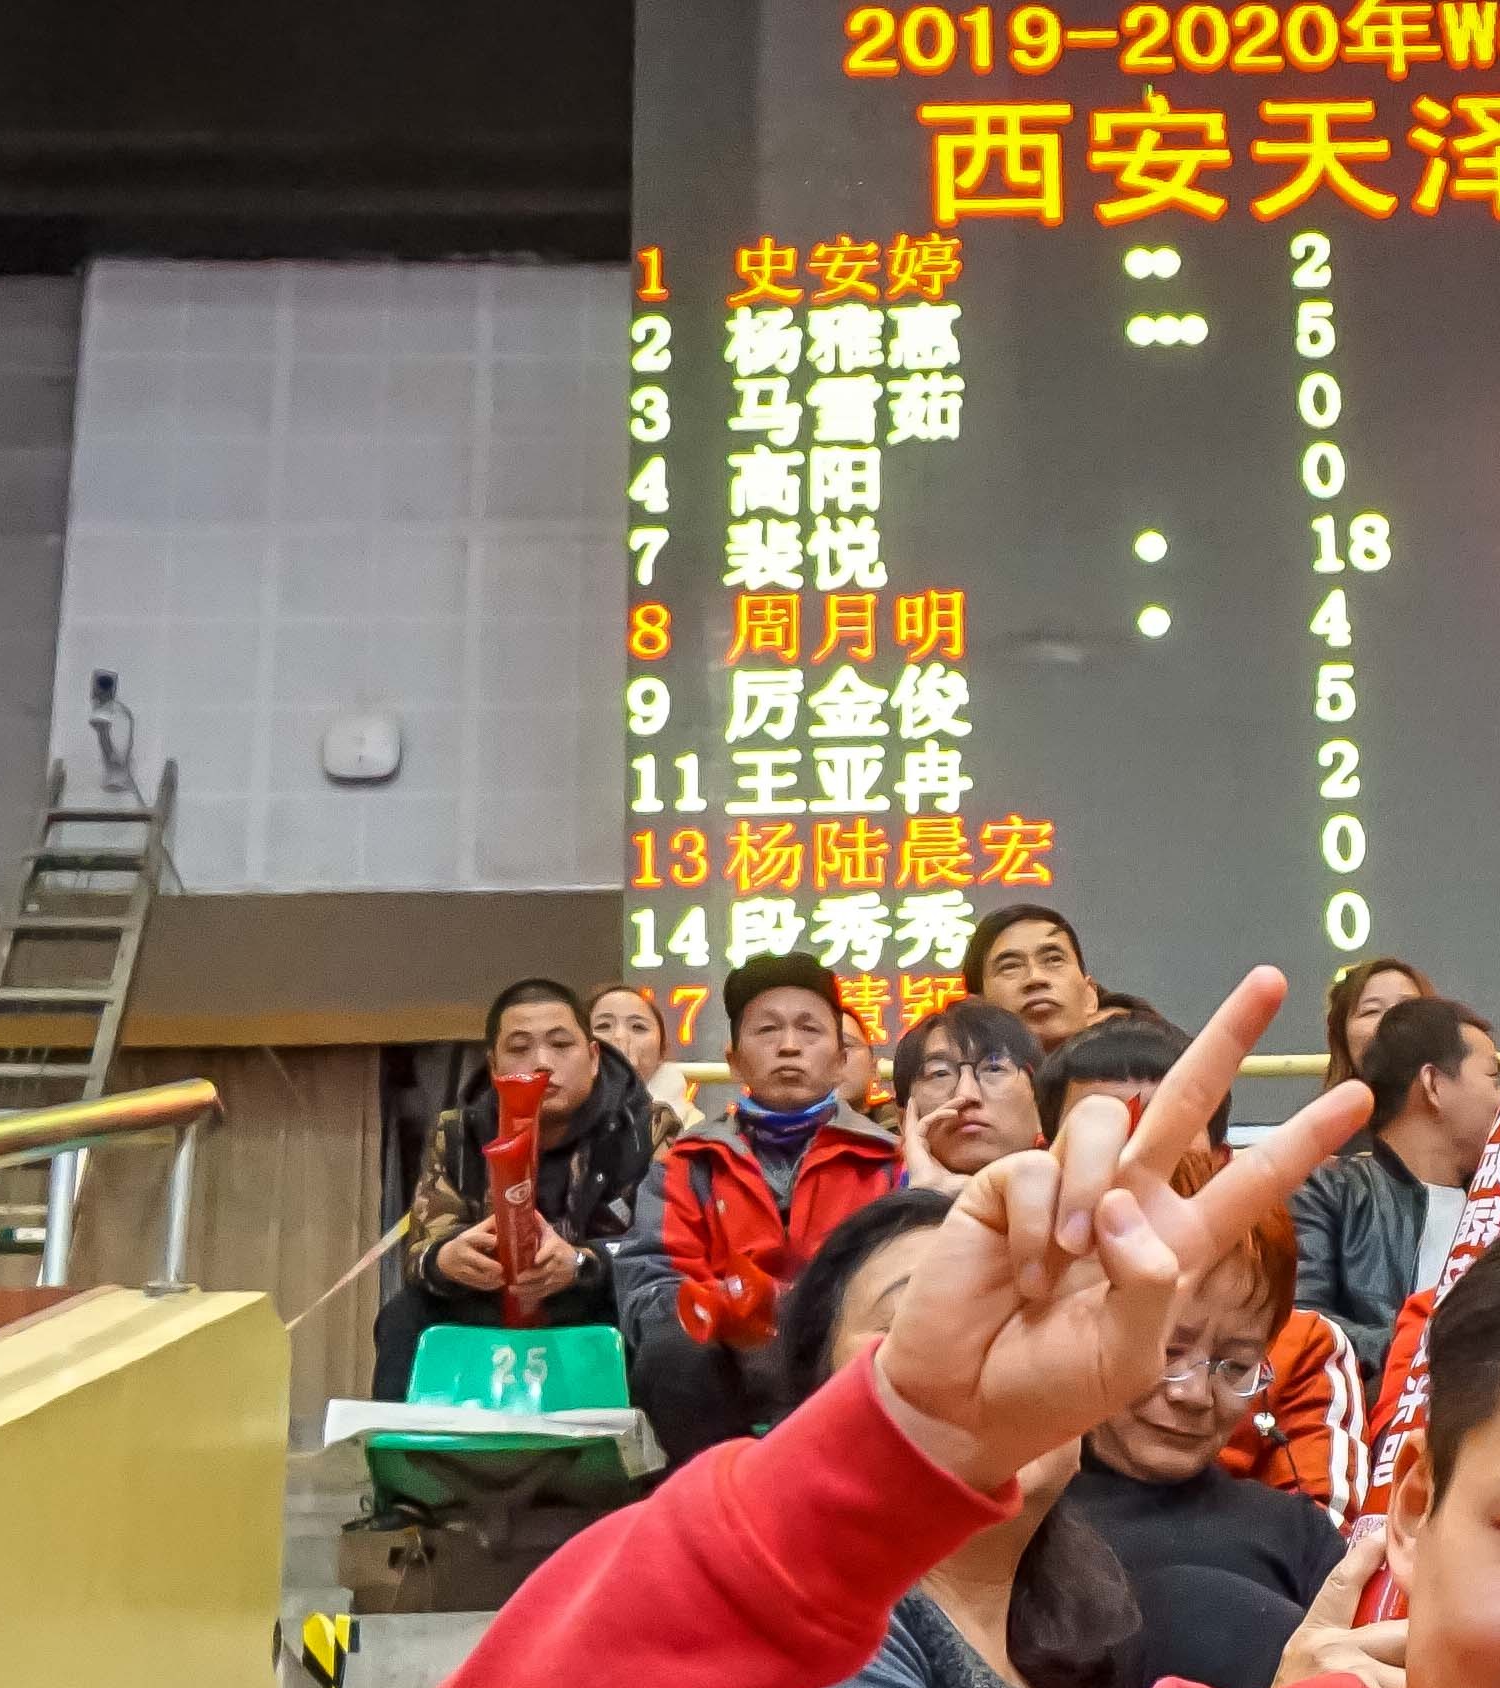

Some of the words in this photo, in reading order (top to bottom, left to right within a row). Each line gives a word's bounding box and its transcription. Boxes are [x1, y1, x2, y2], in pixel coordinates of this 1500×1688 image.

[639, 247, 668, 301] 1
[727, 233, 962, 305] 史安婷
[1291, 233, 1331, 287] 2
[632, 316, 671, 371] 2
[1297, 302, 1335, 357] 5
[631, 386, 670, 442] 3
[1299, 373, 1341, 428] 0
[629, 457, 669, 512] 4
[728, 444, 881, 520] 高阳
[1303, 442, 1345, 498] 0
[630, 528, 669, 585] 7
[1312, 514, 1391, 573] 18
[627, 602, 671, 660] 8
[725, 589, 965, 667] 周月明
[1310, 589, 1351, 646] 4
[627, 677, 670, 735] 9
[1316, 663, 1356, 721] 5
[632, 753, 707, 812] 11
[1318, 740, 1360, 798] 2
[631, 827, 711, 889] 13
[723, 813, 1054, 895] 杨陆晨宏
[1322, 814, 1365, 873] 0
[631, 906, 709, 967] 14
[1326, 892, 1370, 951] 0
